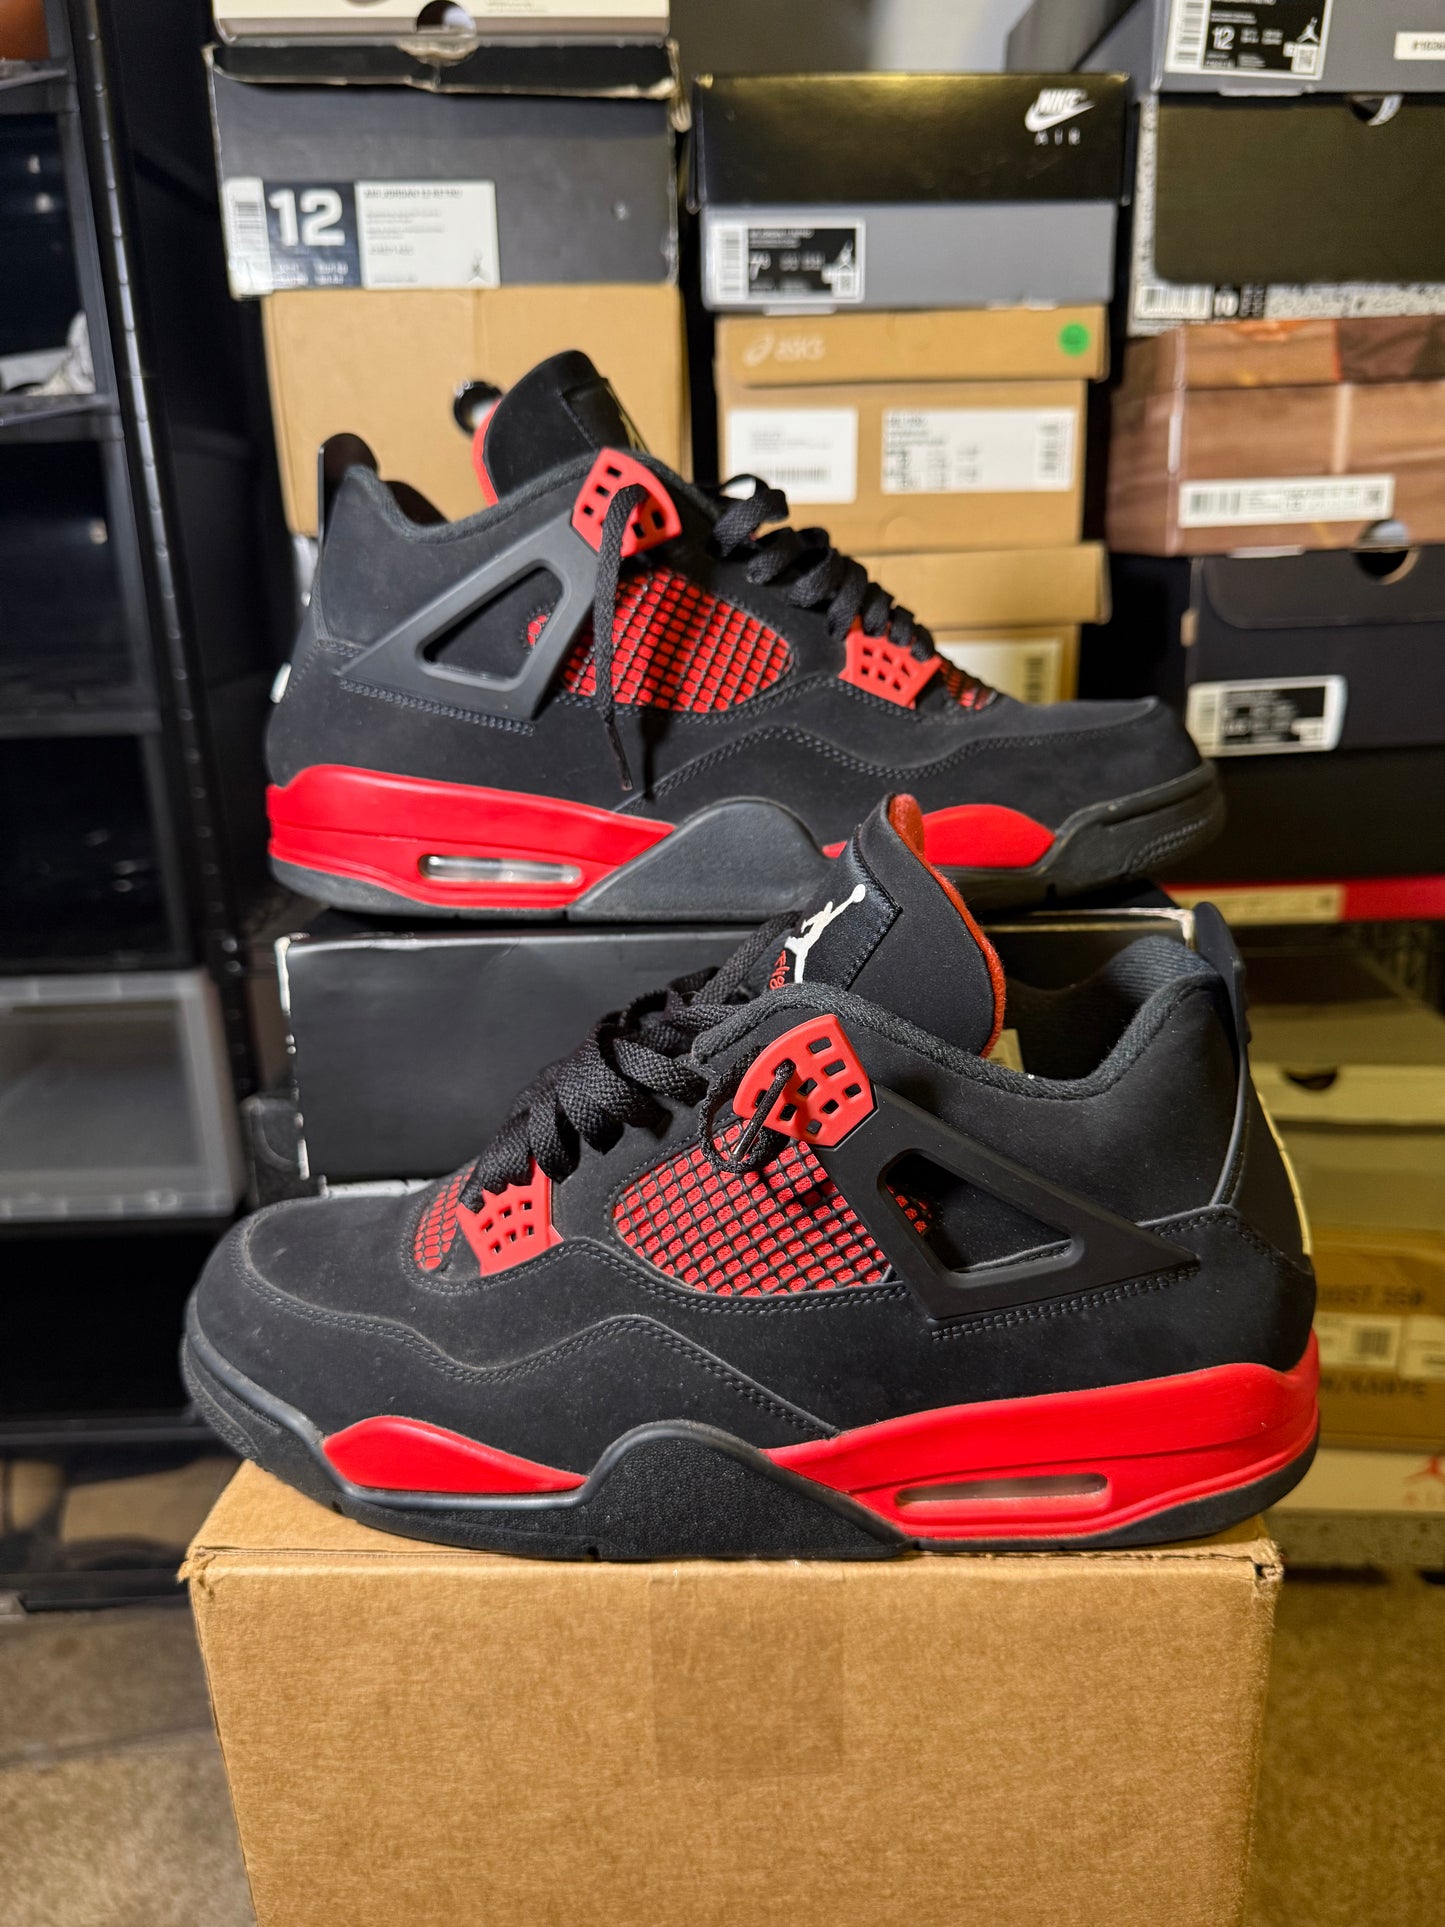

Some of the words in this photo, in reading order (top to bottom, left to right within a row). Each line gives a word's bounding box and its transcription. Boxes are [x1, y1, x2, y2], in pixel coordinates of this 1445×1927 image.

[1212, 26, 1235, 50] 12
[1034, 88, 1088, 113] NIKE
[269, 188, 345, 247] 12
